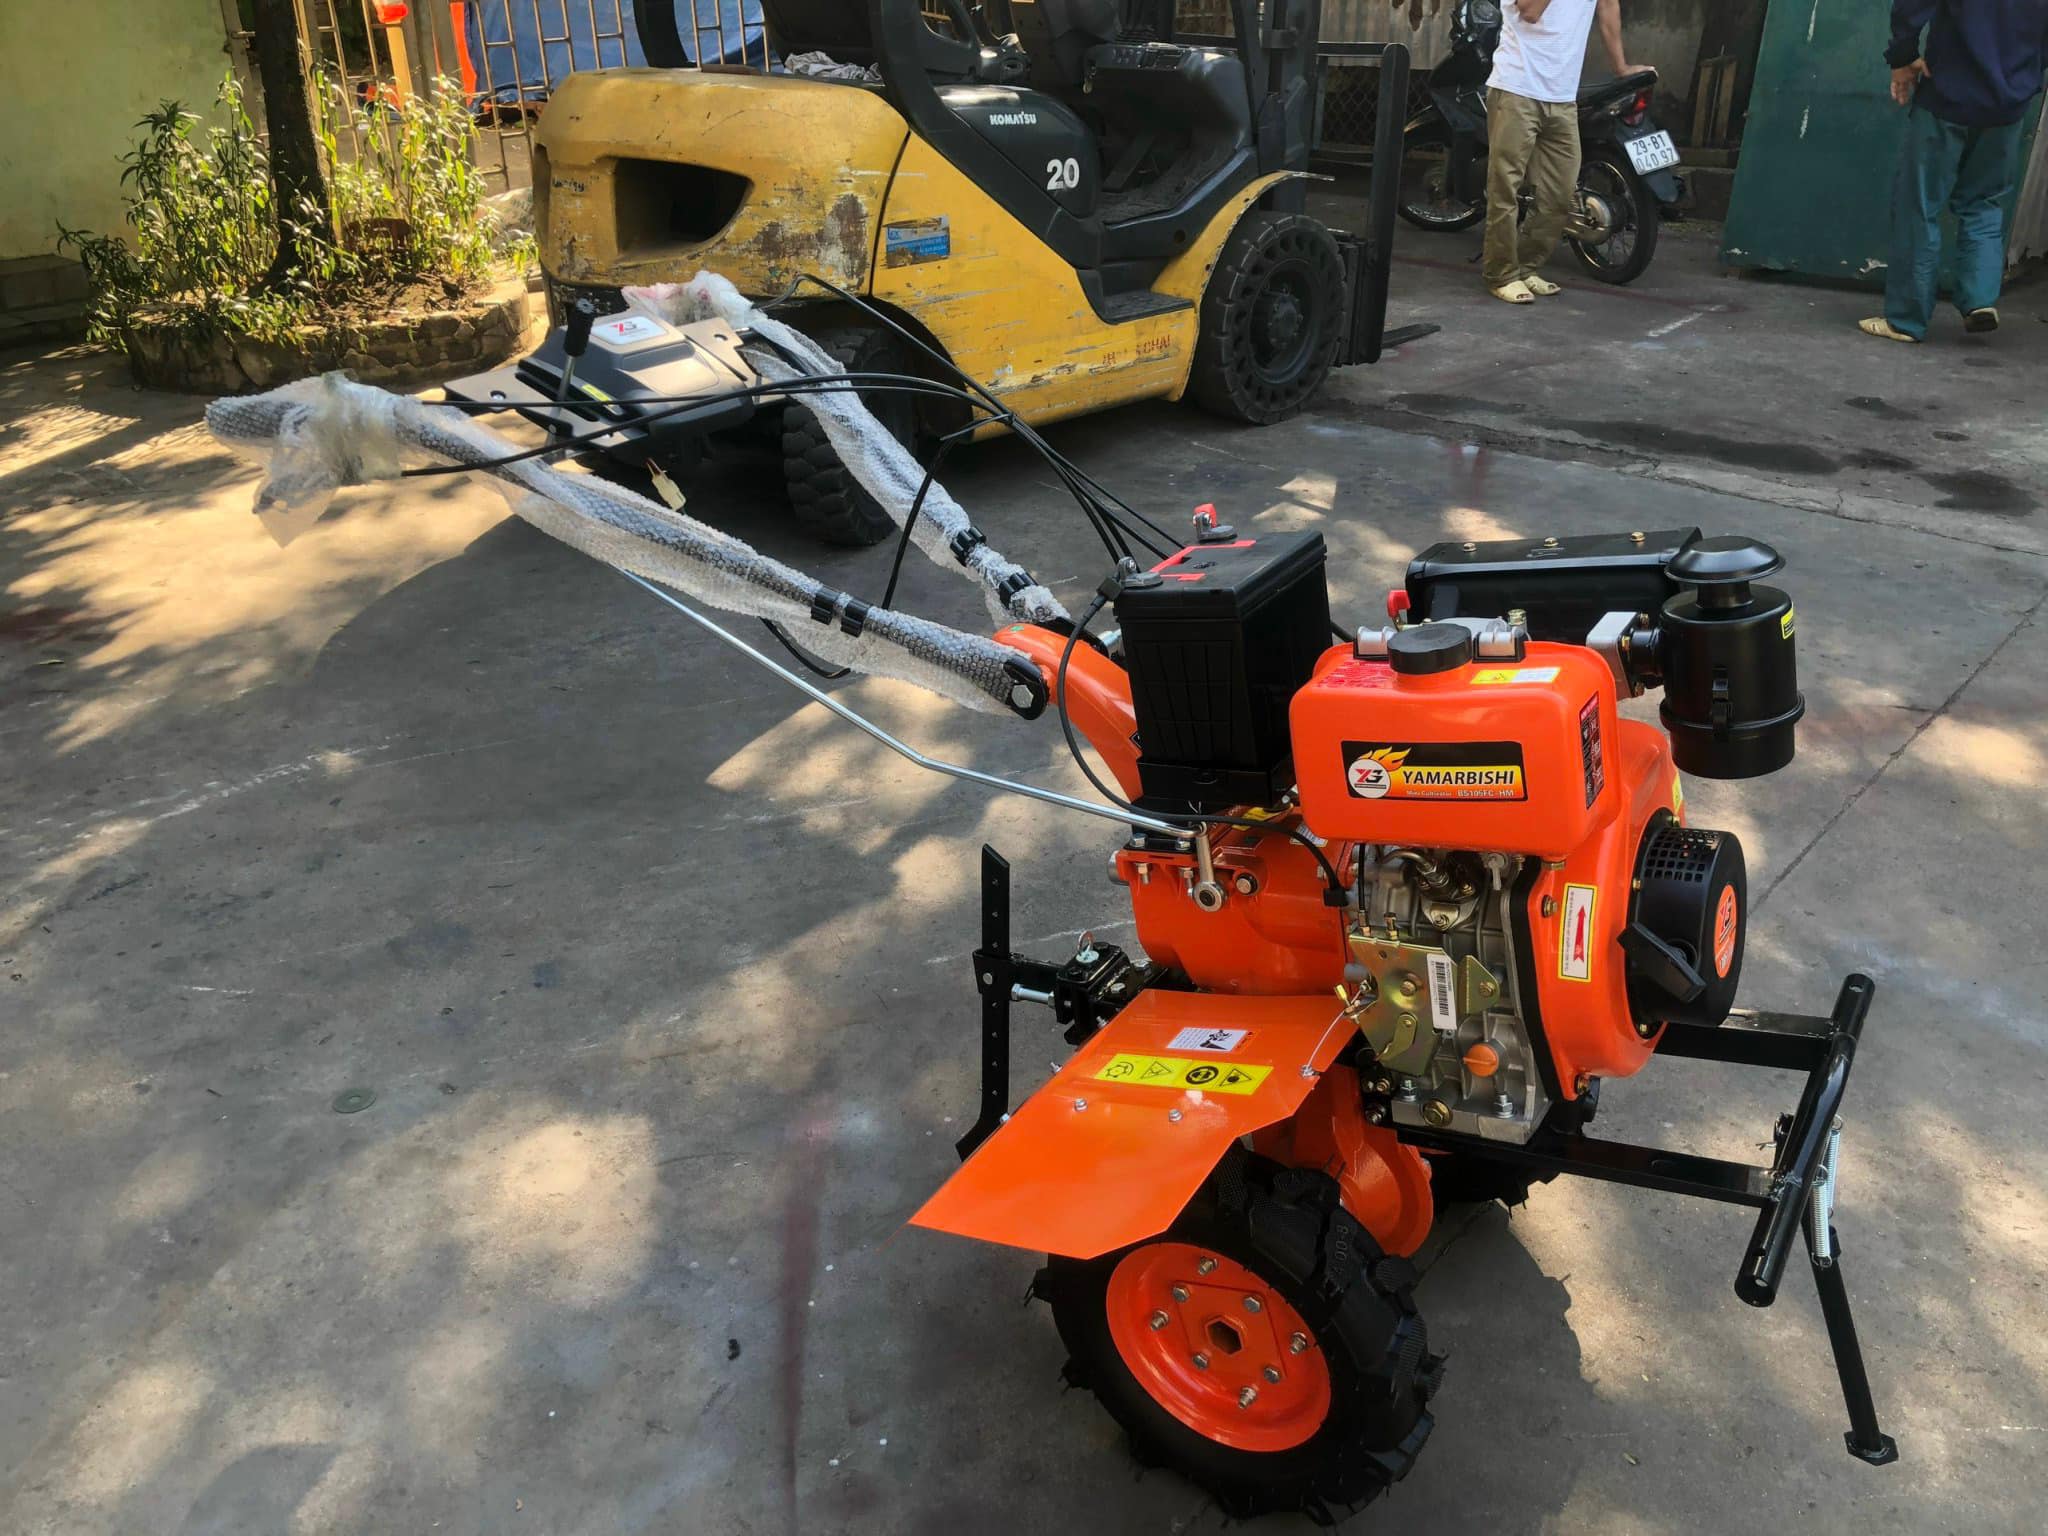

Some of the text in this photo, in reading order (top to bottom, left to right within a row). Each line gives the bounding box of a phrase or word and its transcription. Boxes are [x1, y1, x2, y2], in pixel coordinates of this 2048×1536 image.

[990, 111, 1037, 125] KOMATSU
[1632, 134, 1666, 155] 29-B1
[1046, 157, 1080, 190] 20
[1403, 770, 1515, 785] YAMARBISHI
